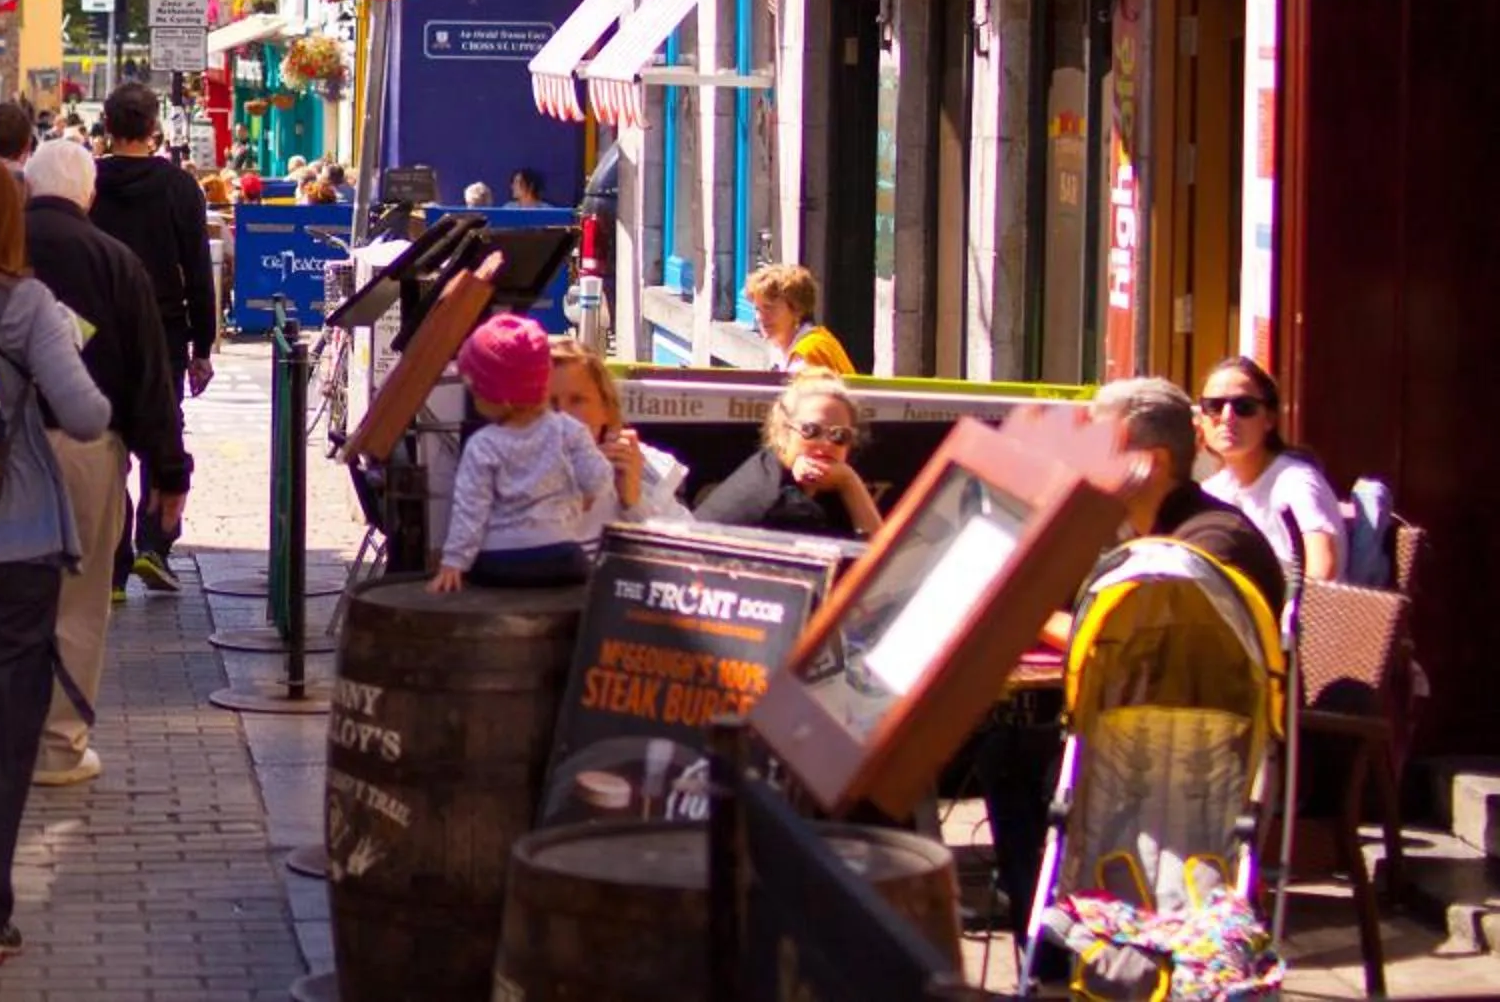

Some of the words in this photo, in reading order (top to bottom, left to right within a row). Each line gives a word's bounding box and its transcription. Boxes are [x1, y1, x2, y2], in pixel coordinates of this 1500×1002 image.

[613, 579, 645, 600] THE
[646, 581, 739, 620] FRONT
[737, 598, 785, 624] DOOR
[581, 666, 660, 721] STEAK
